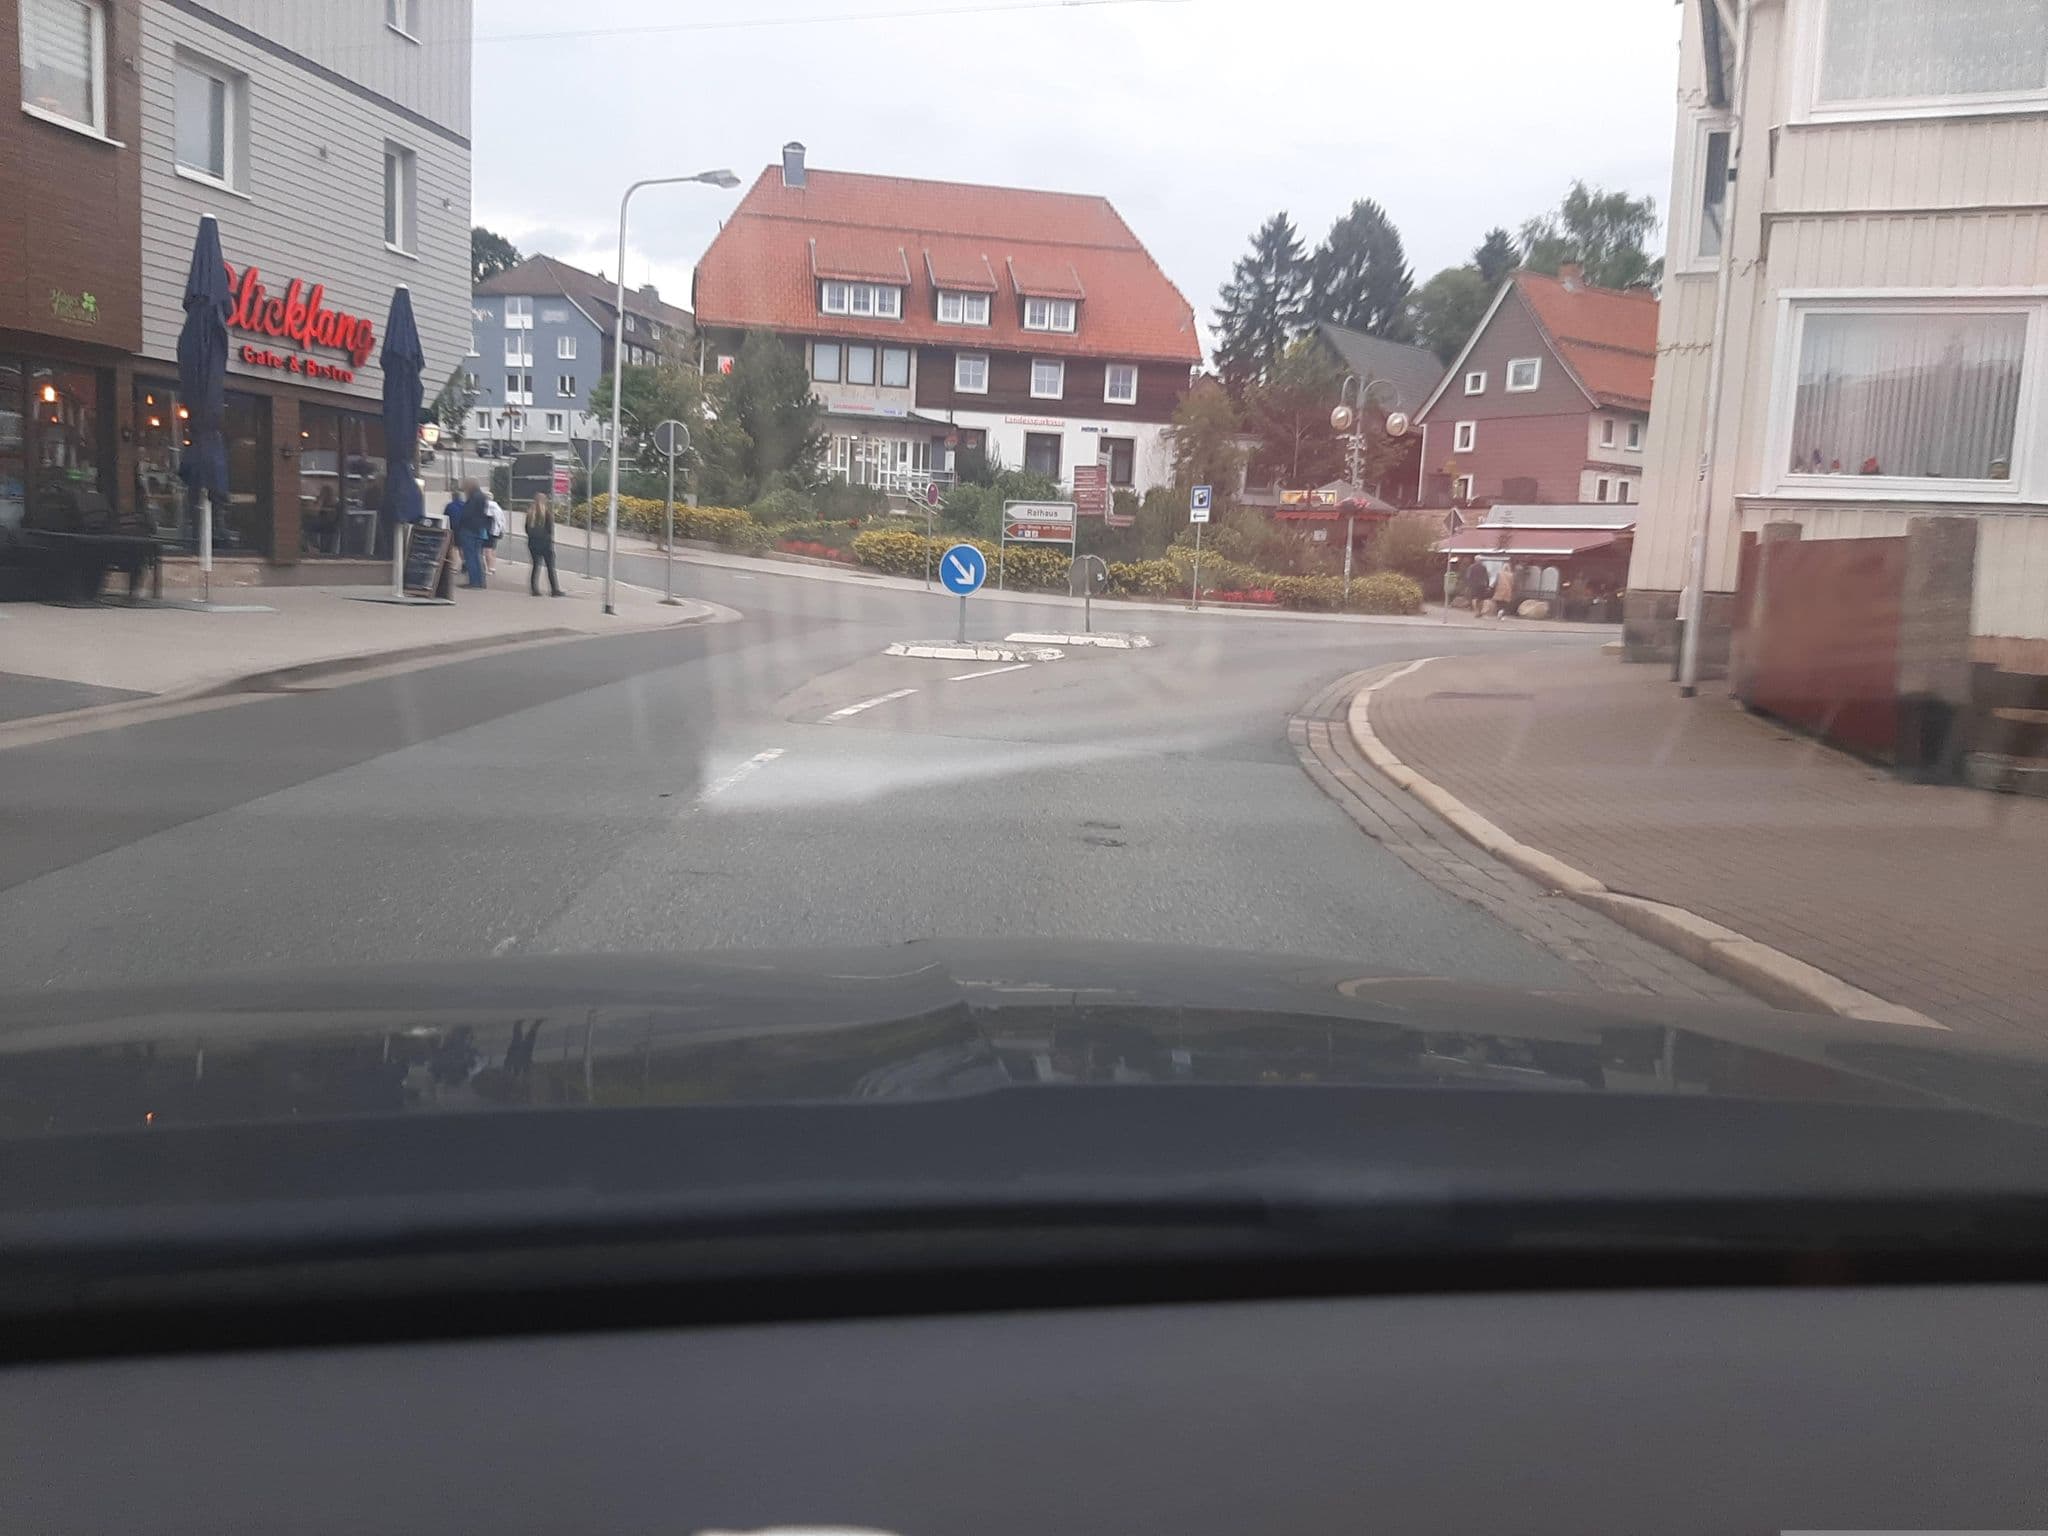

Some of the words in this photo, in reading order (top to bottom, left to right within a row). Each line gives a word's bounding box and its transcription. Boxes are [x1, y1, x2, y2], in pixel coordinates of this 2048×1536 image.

[289, 355, 300, 373] &
[306, 359, 355, 383] Bistro
[1026, 508, 1059, 518] Rathaus
